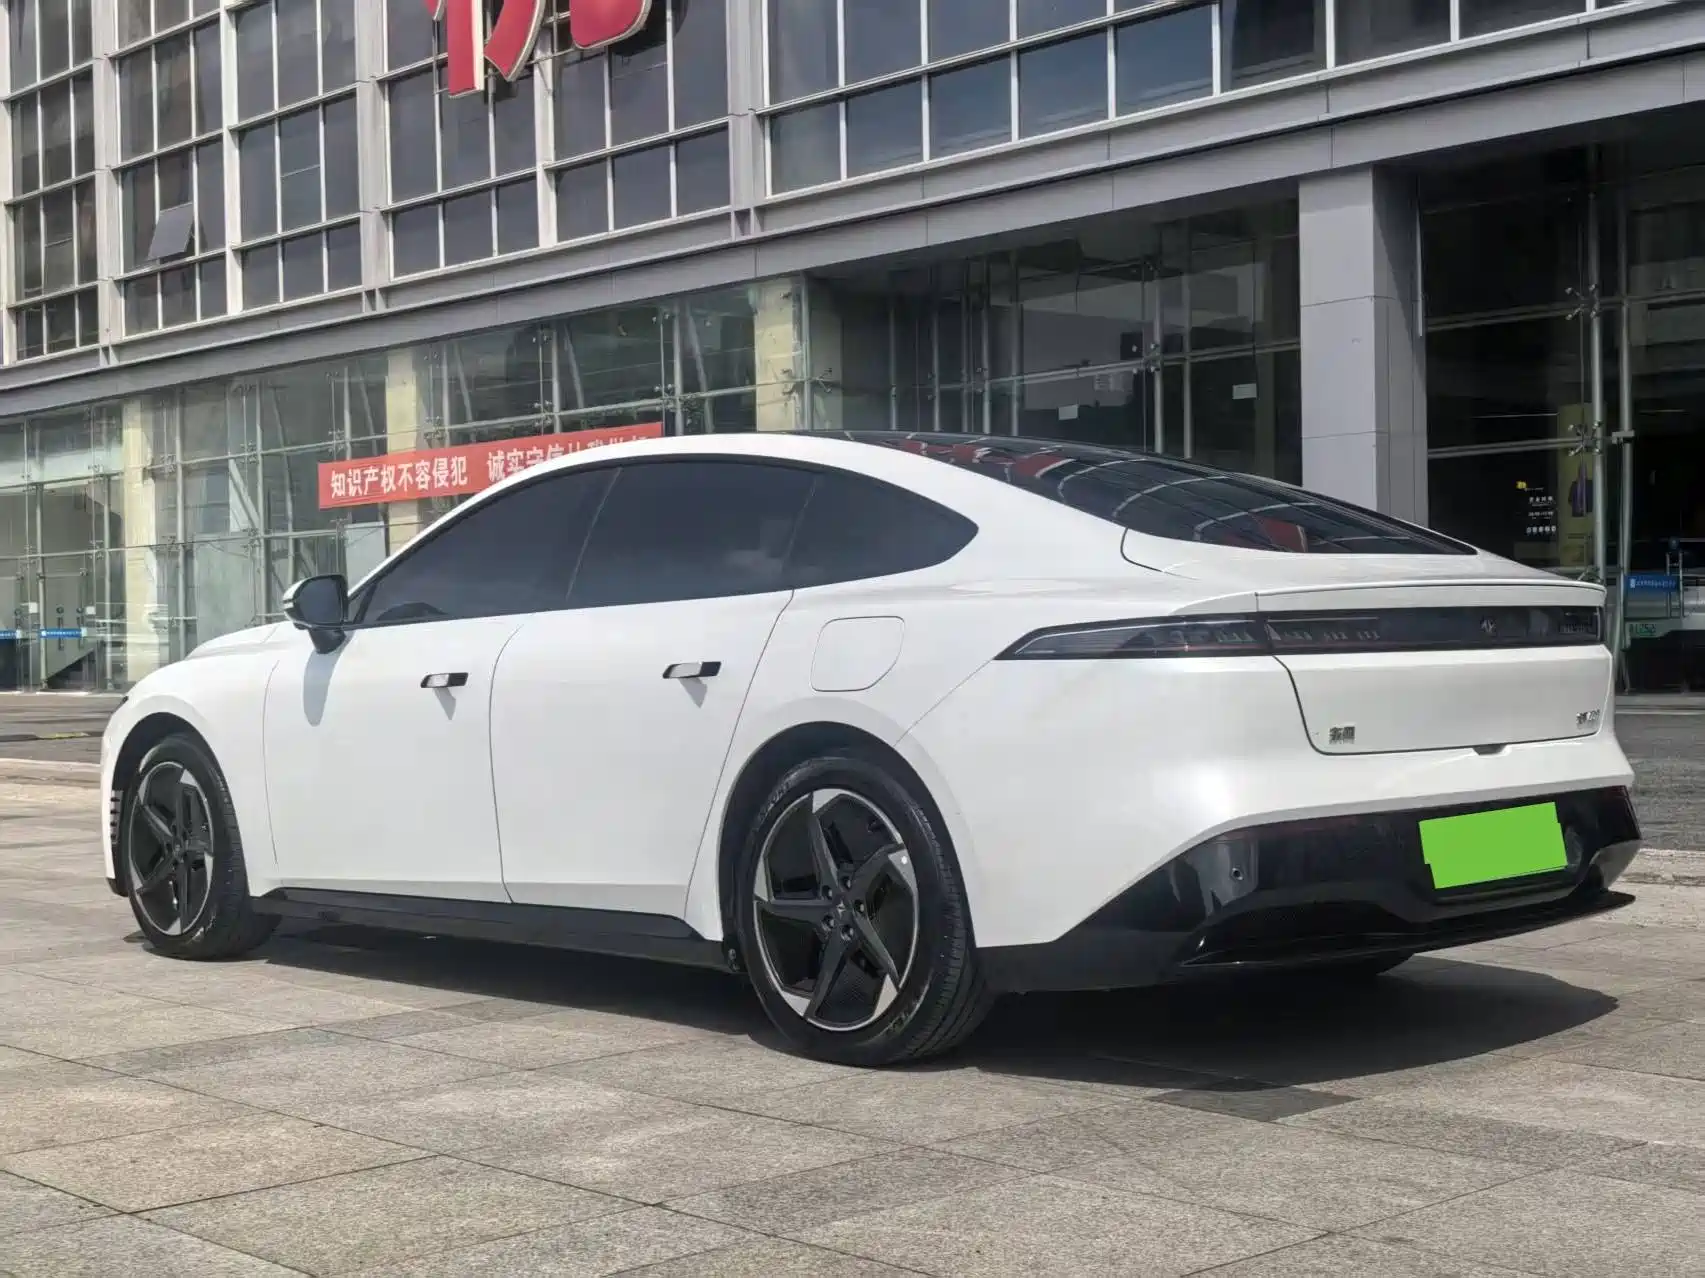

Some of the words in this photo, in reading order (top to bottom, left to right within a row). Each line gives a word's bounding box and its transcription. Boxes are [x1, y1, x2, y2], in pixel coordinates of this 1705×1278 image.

[330, 455, 469, 498] 知识产权不容侵犯
